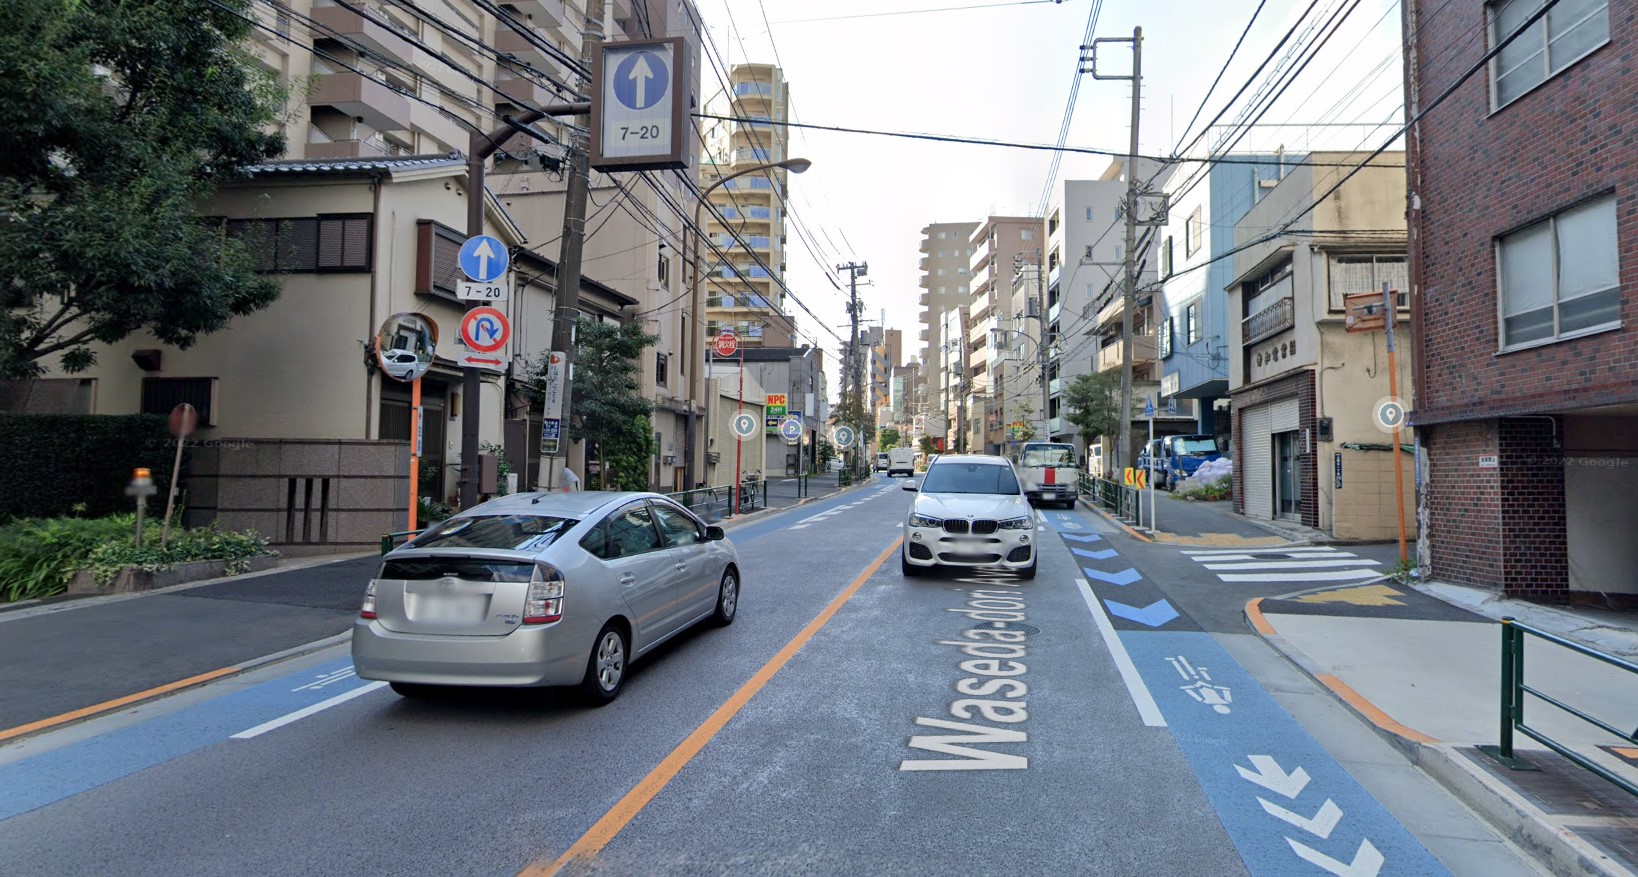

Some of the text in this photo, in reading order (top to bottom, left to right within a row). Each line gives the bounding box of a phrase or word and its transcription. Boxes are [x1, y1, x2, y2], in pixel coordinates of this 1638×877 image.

[620, 125, 660, 141] 7-20
[718, 339, 736, 349] 消火栓
[767, 394, 785, 405] NPC
[770, 406, 783, 414] 24H
